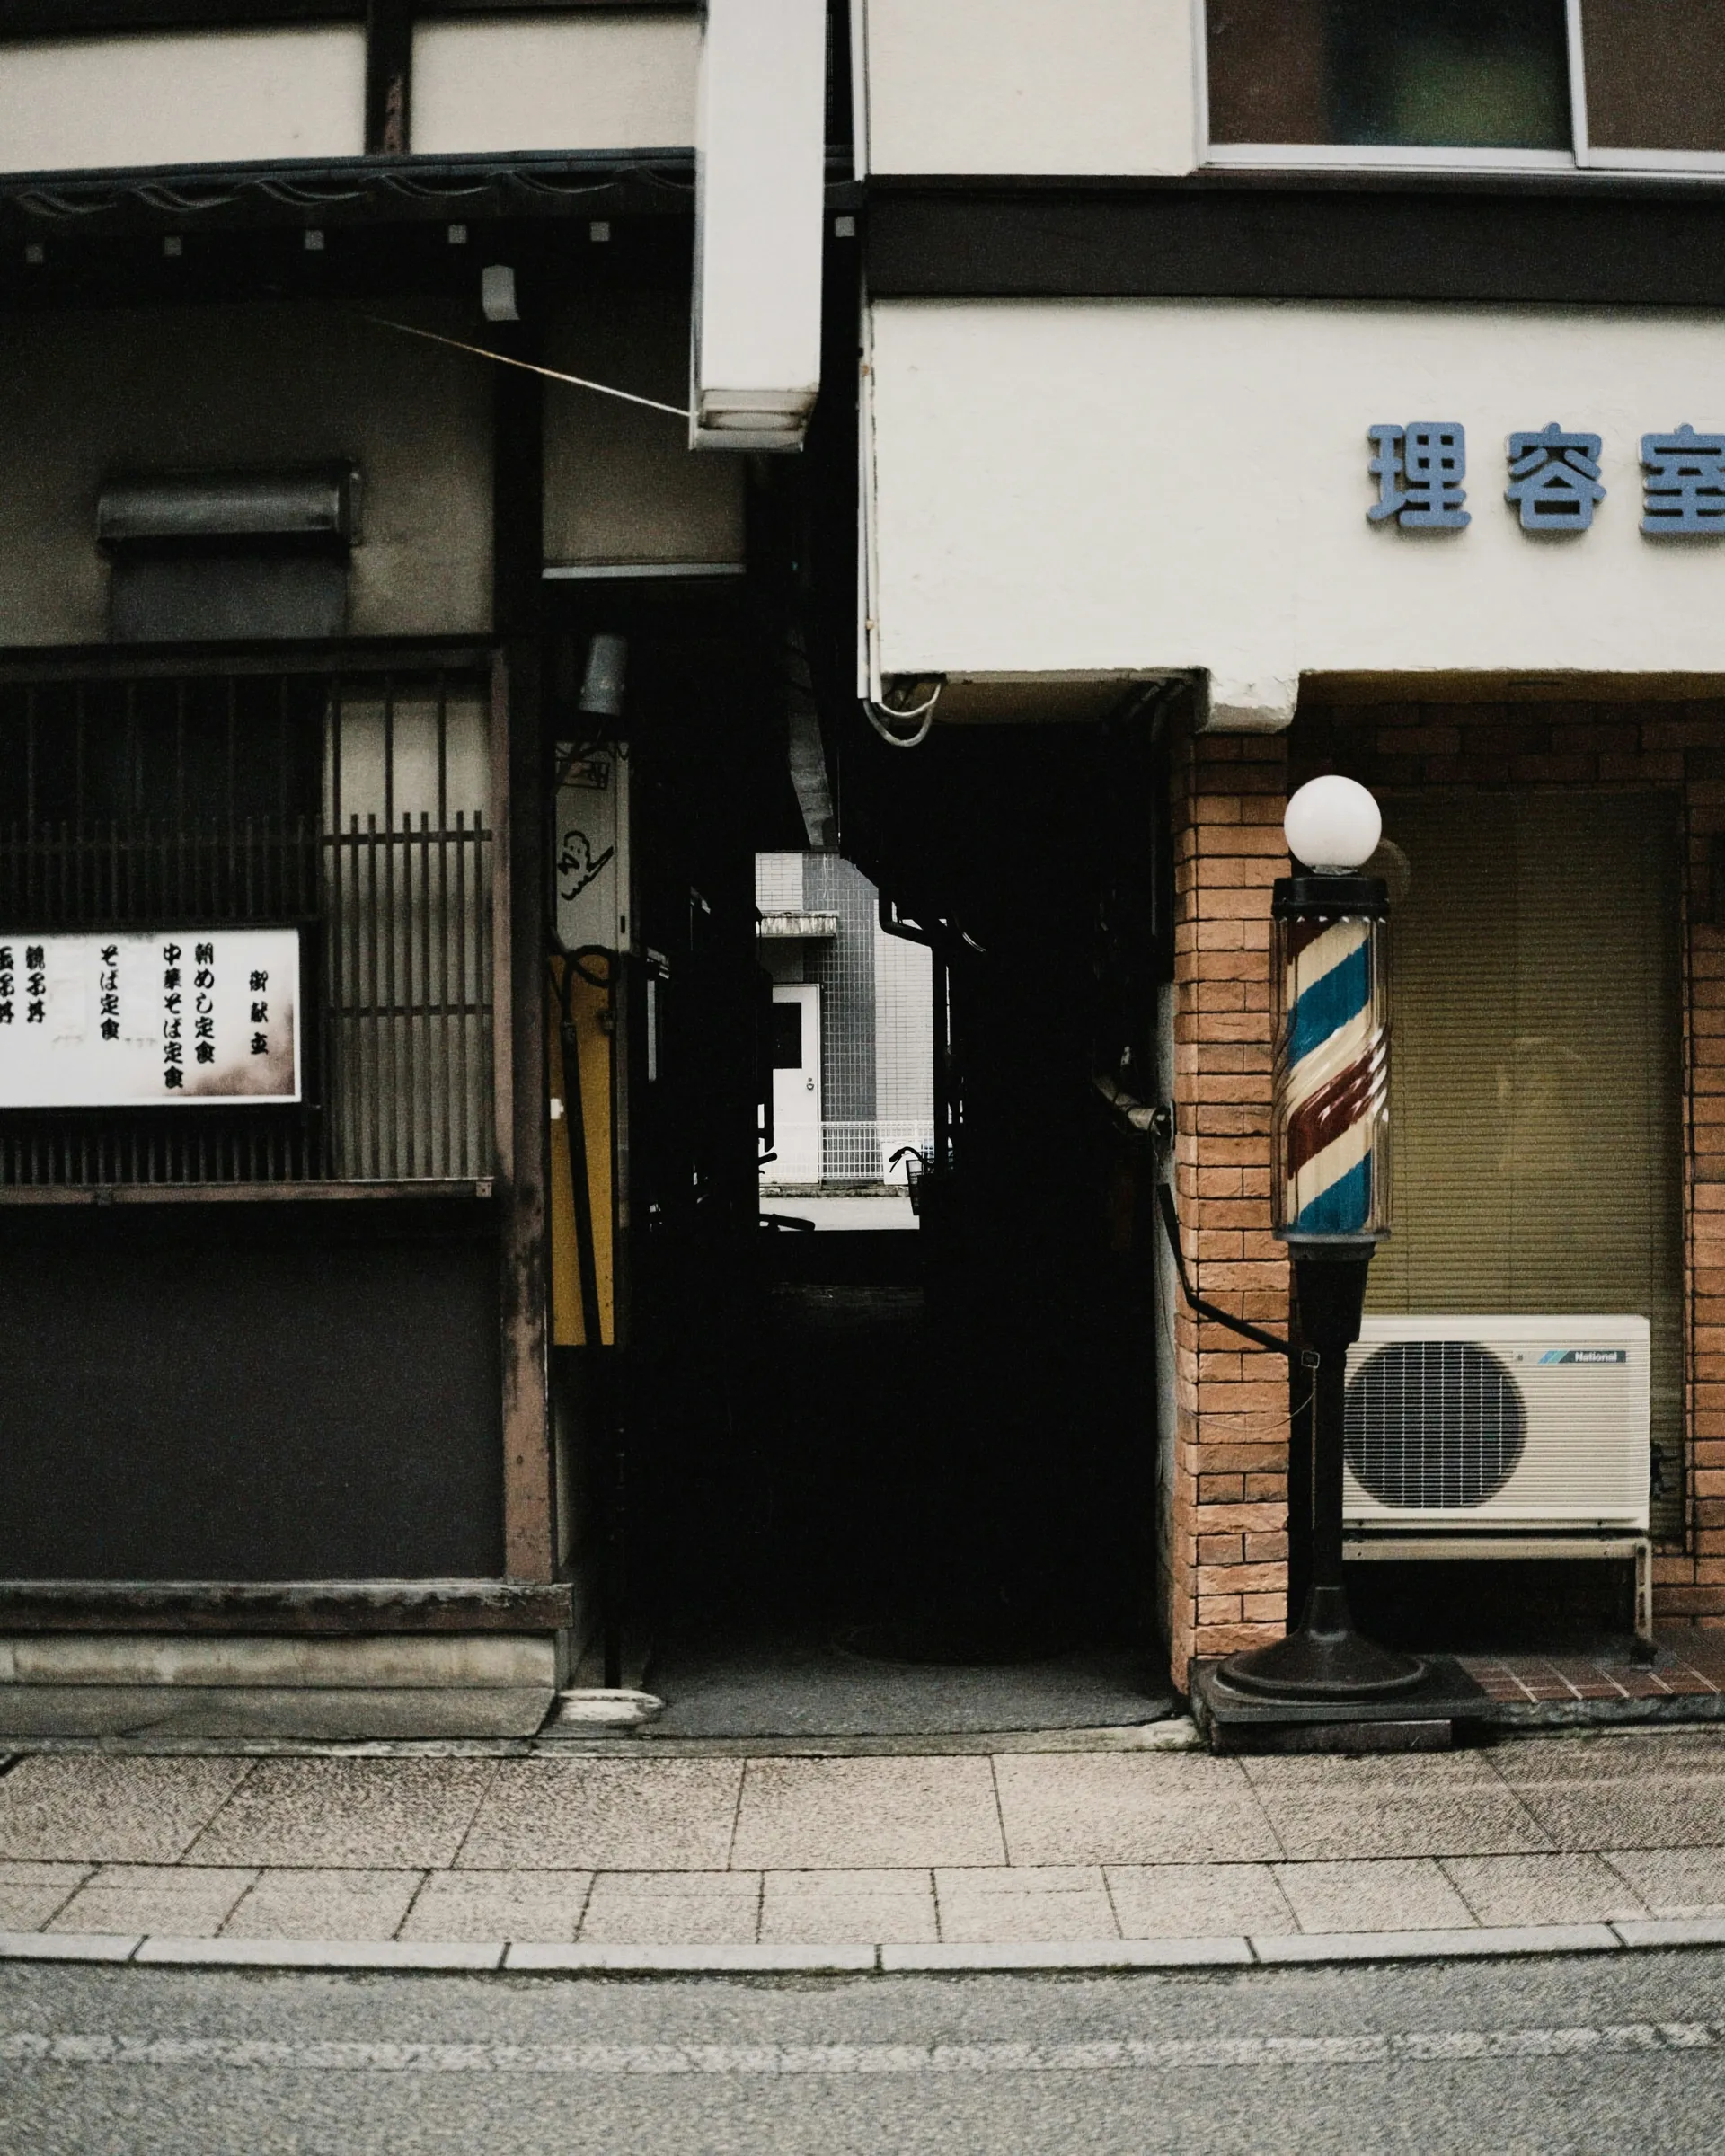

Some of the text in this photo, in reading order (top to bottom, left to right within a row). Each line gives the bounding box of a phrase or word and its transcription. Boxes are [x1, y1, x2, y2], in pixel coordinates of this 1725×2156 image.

[1366, 421, 1725, 533] 理容室
[25, 944, 47, 1024] 親子丼
[100, 944, 119, 1041] そば定食
[163, 943, 183, 1089] 中華そば定食
[194, 942, 215, 1064] 朝めし定食
[249, 969, 269, 1056] 御献立
[1574, 1351, 1618, 1363] National
